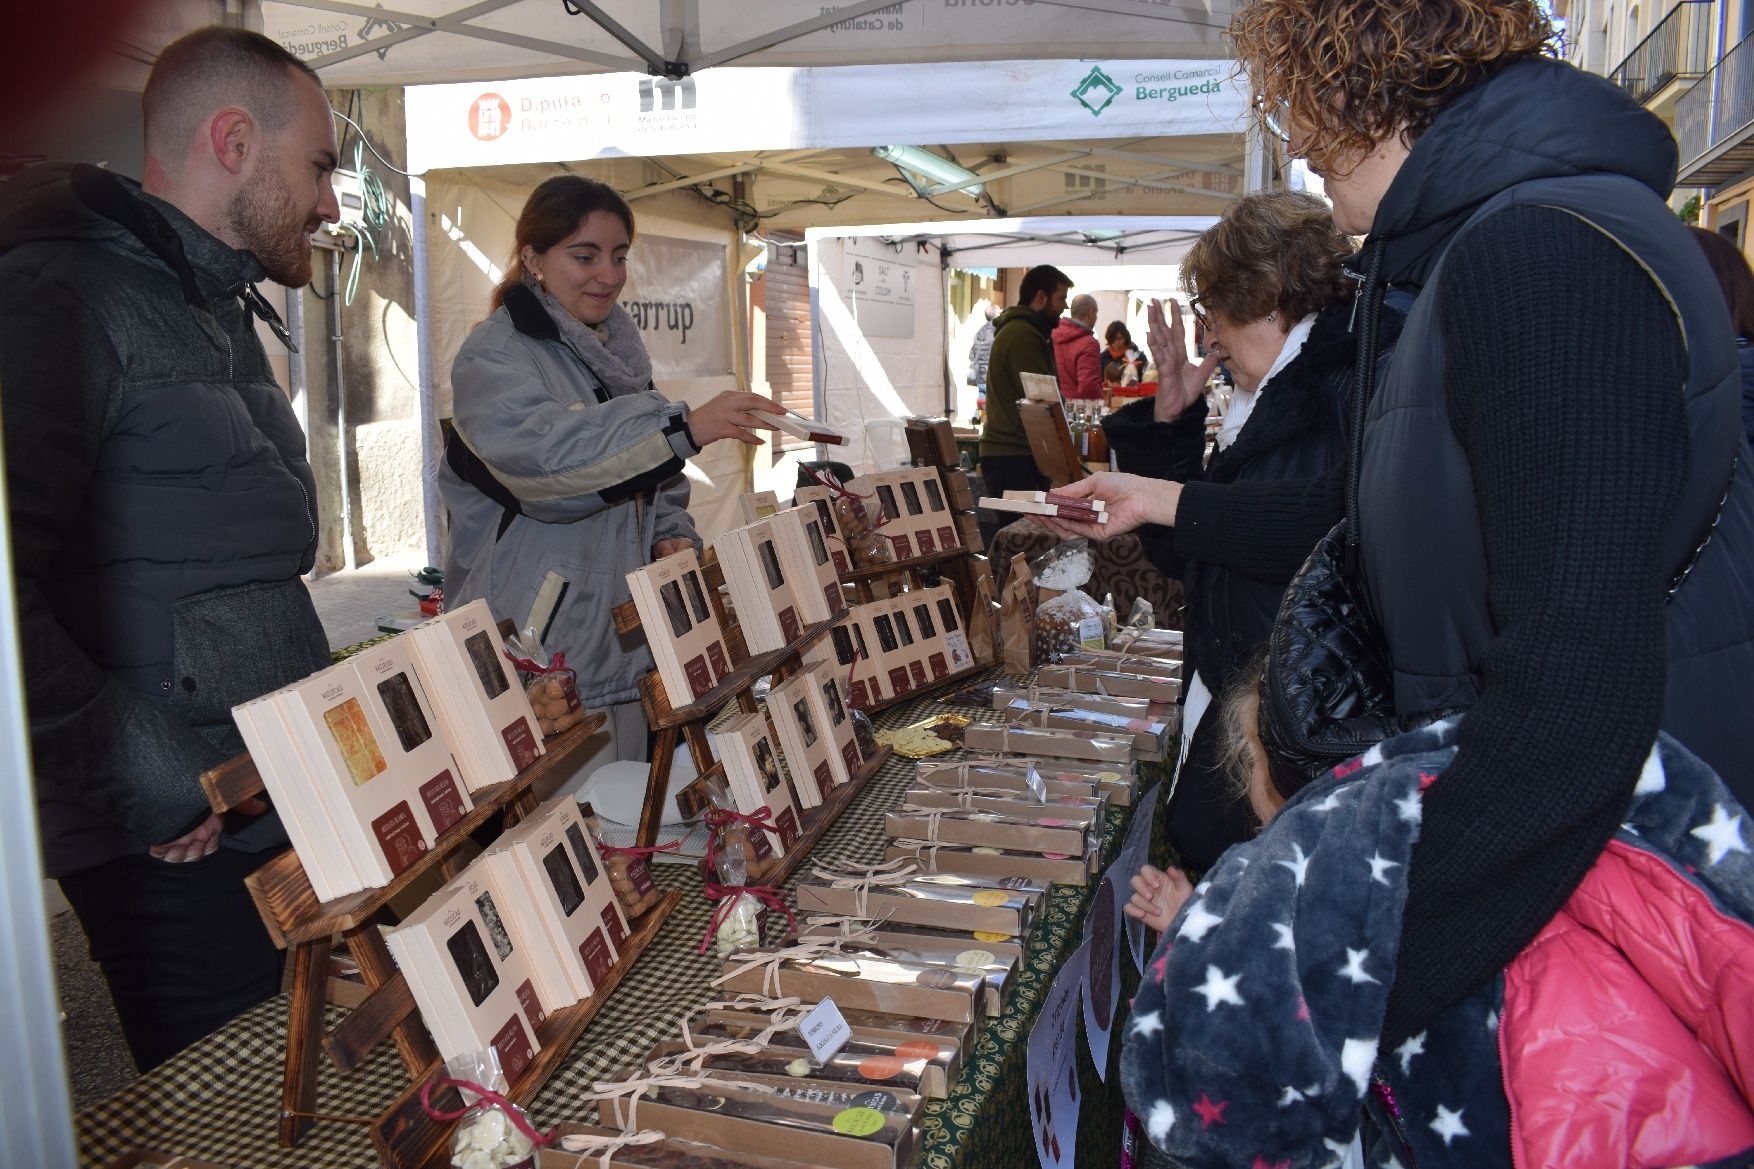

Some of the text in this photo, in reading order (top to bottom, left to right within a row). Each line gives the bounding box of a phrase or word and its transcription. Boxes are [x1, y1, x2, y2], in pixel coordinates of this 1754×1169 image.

[1135, 65, 1221, 84] Consell Comarcal
[1136, 79, 1222, 102] Berguedà
[622, 301, 694, 345] arrup
